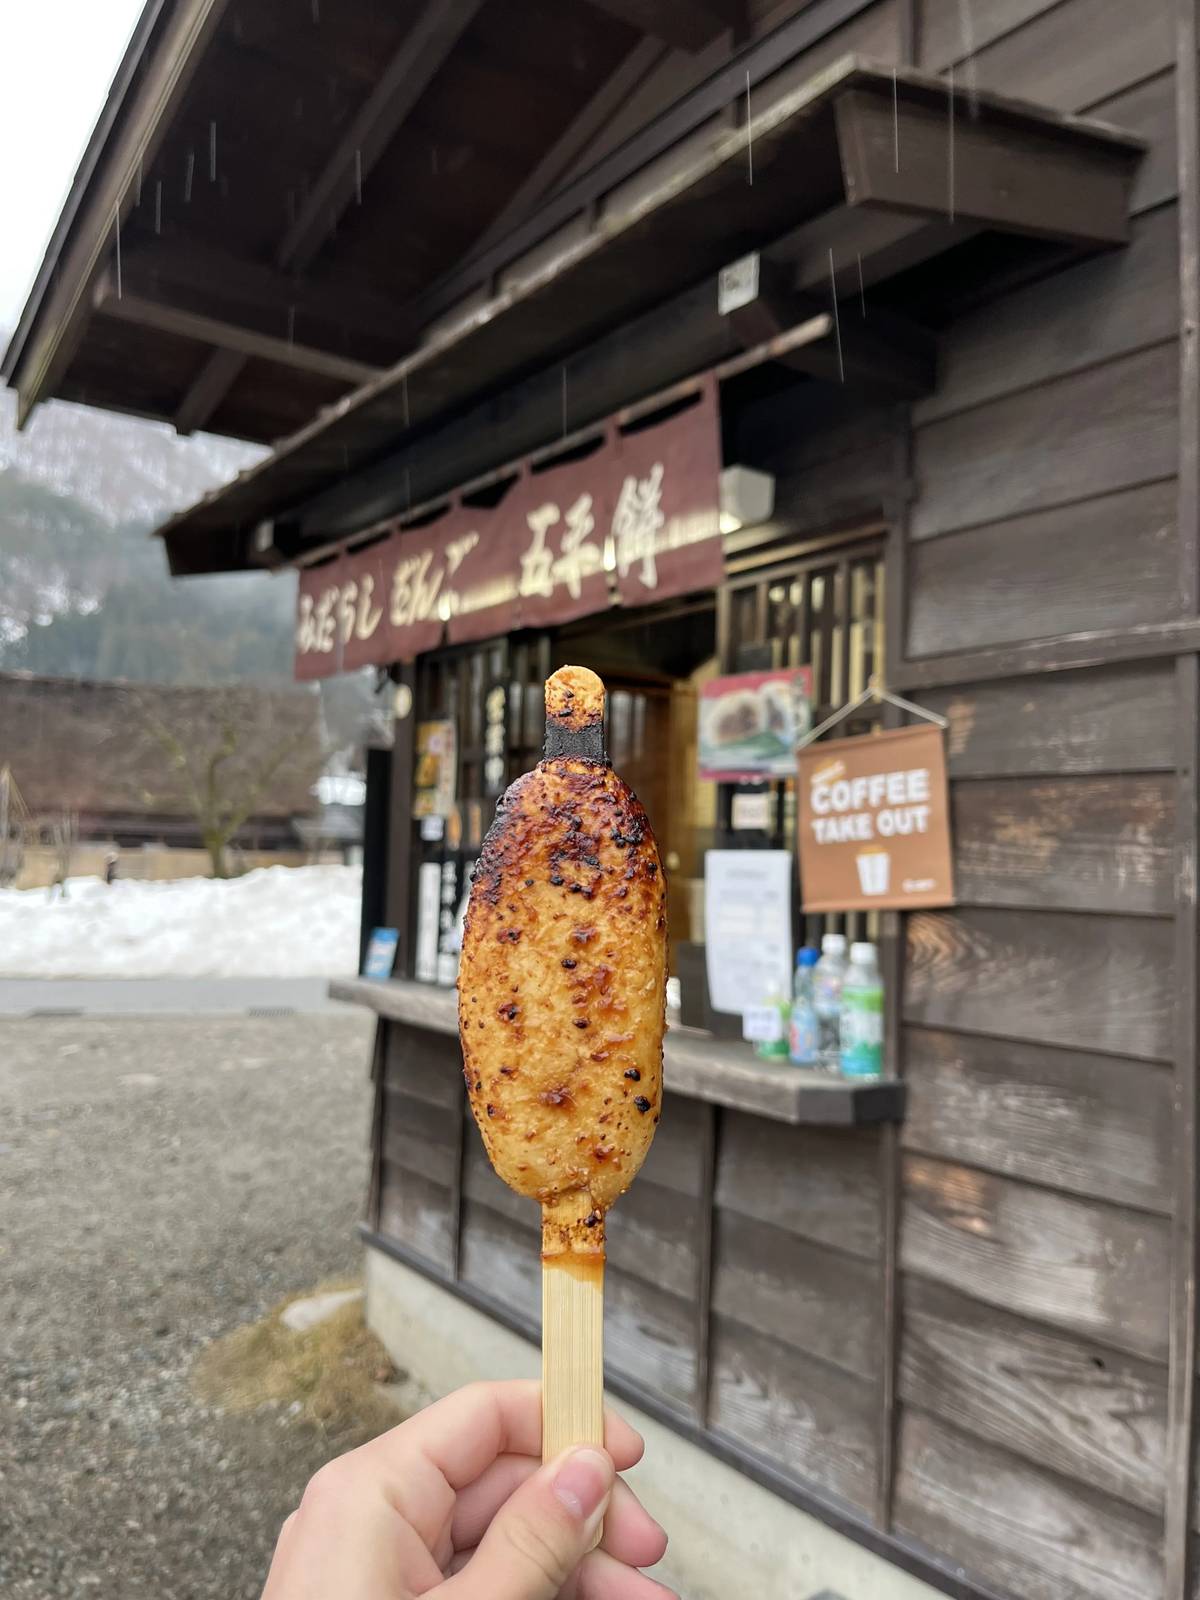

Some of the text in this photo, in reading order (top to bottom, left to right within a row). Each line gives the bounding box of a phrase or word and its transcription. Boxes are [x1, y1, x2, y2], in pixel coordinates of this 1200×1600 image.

[519, 462, 665, 599] 五平餅
[811, 769, 929, 814] COFFEE
[812, 807, 930, 844] TAKE OUT
